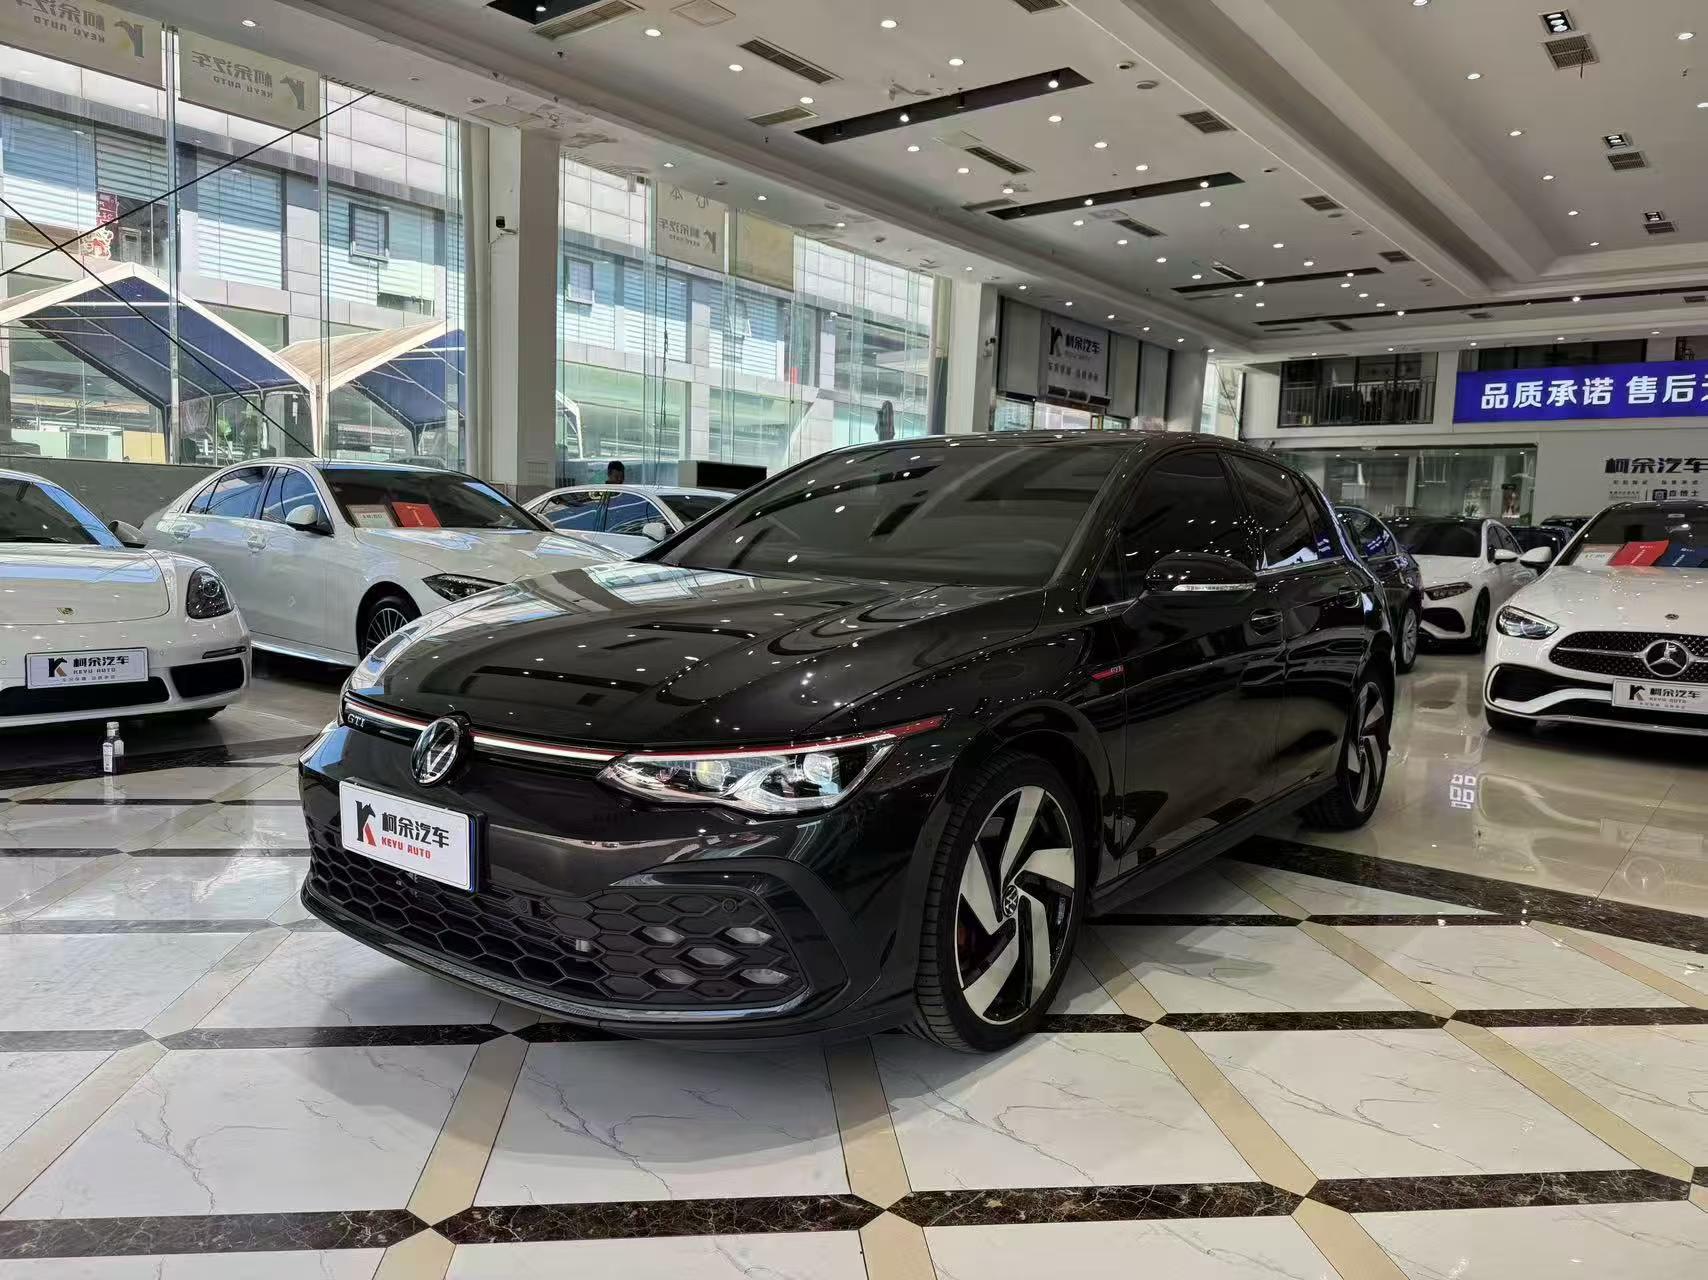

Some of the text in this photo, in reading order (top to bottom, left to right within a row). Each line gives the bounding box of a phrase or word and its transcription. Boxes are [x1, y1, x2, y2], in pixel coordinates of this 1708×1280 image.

[1480, 373, 1708, 410] 品质承诺 售后
[1605, 457, 1708, 474] 柯余汽车
[73, 655, 129, 668] 柯余汽车
[1649, 687, 1700, 699] 柯余汽车
[347, 713, 365, 728] GTI
[381, 811, 450, 849] 柯余汽车
[381, 836, 431, 860] KEYU AUTO
